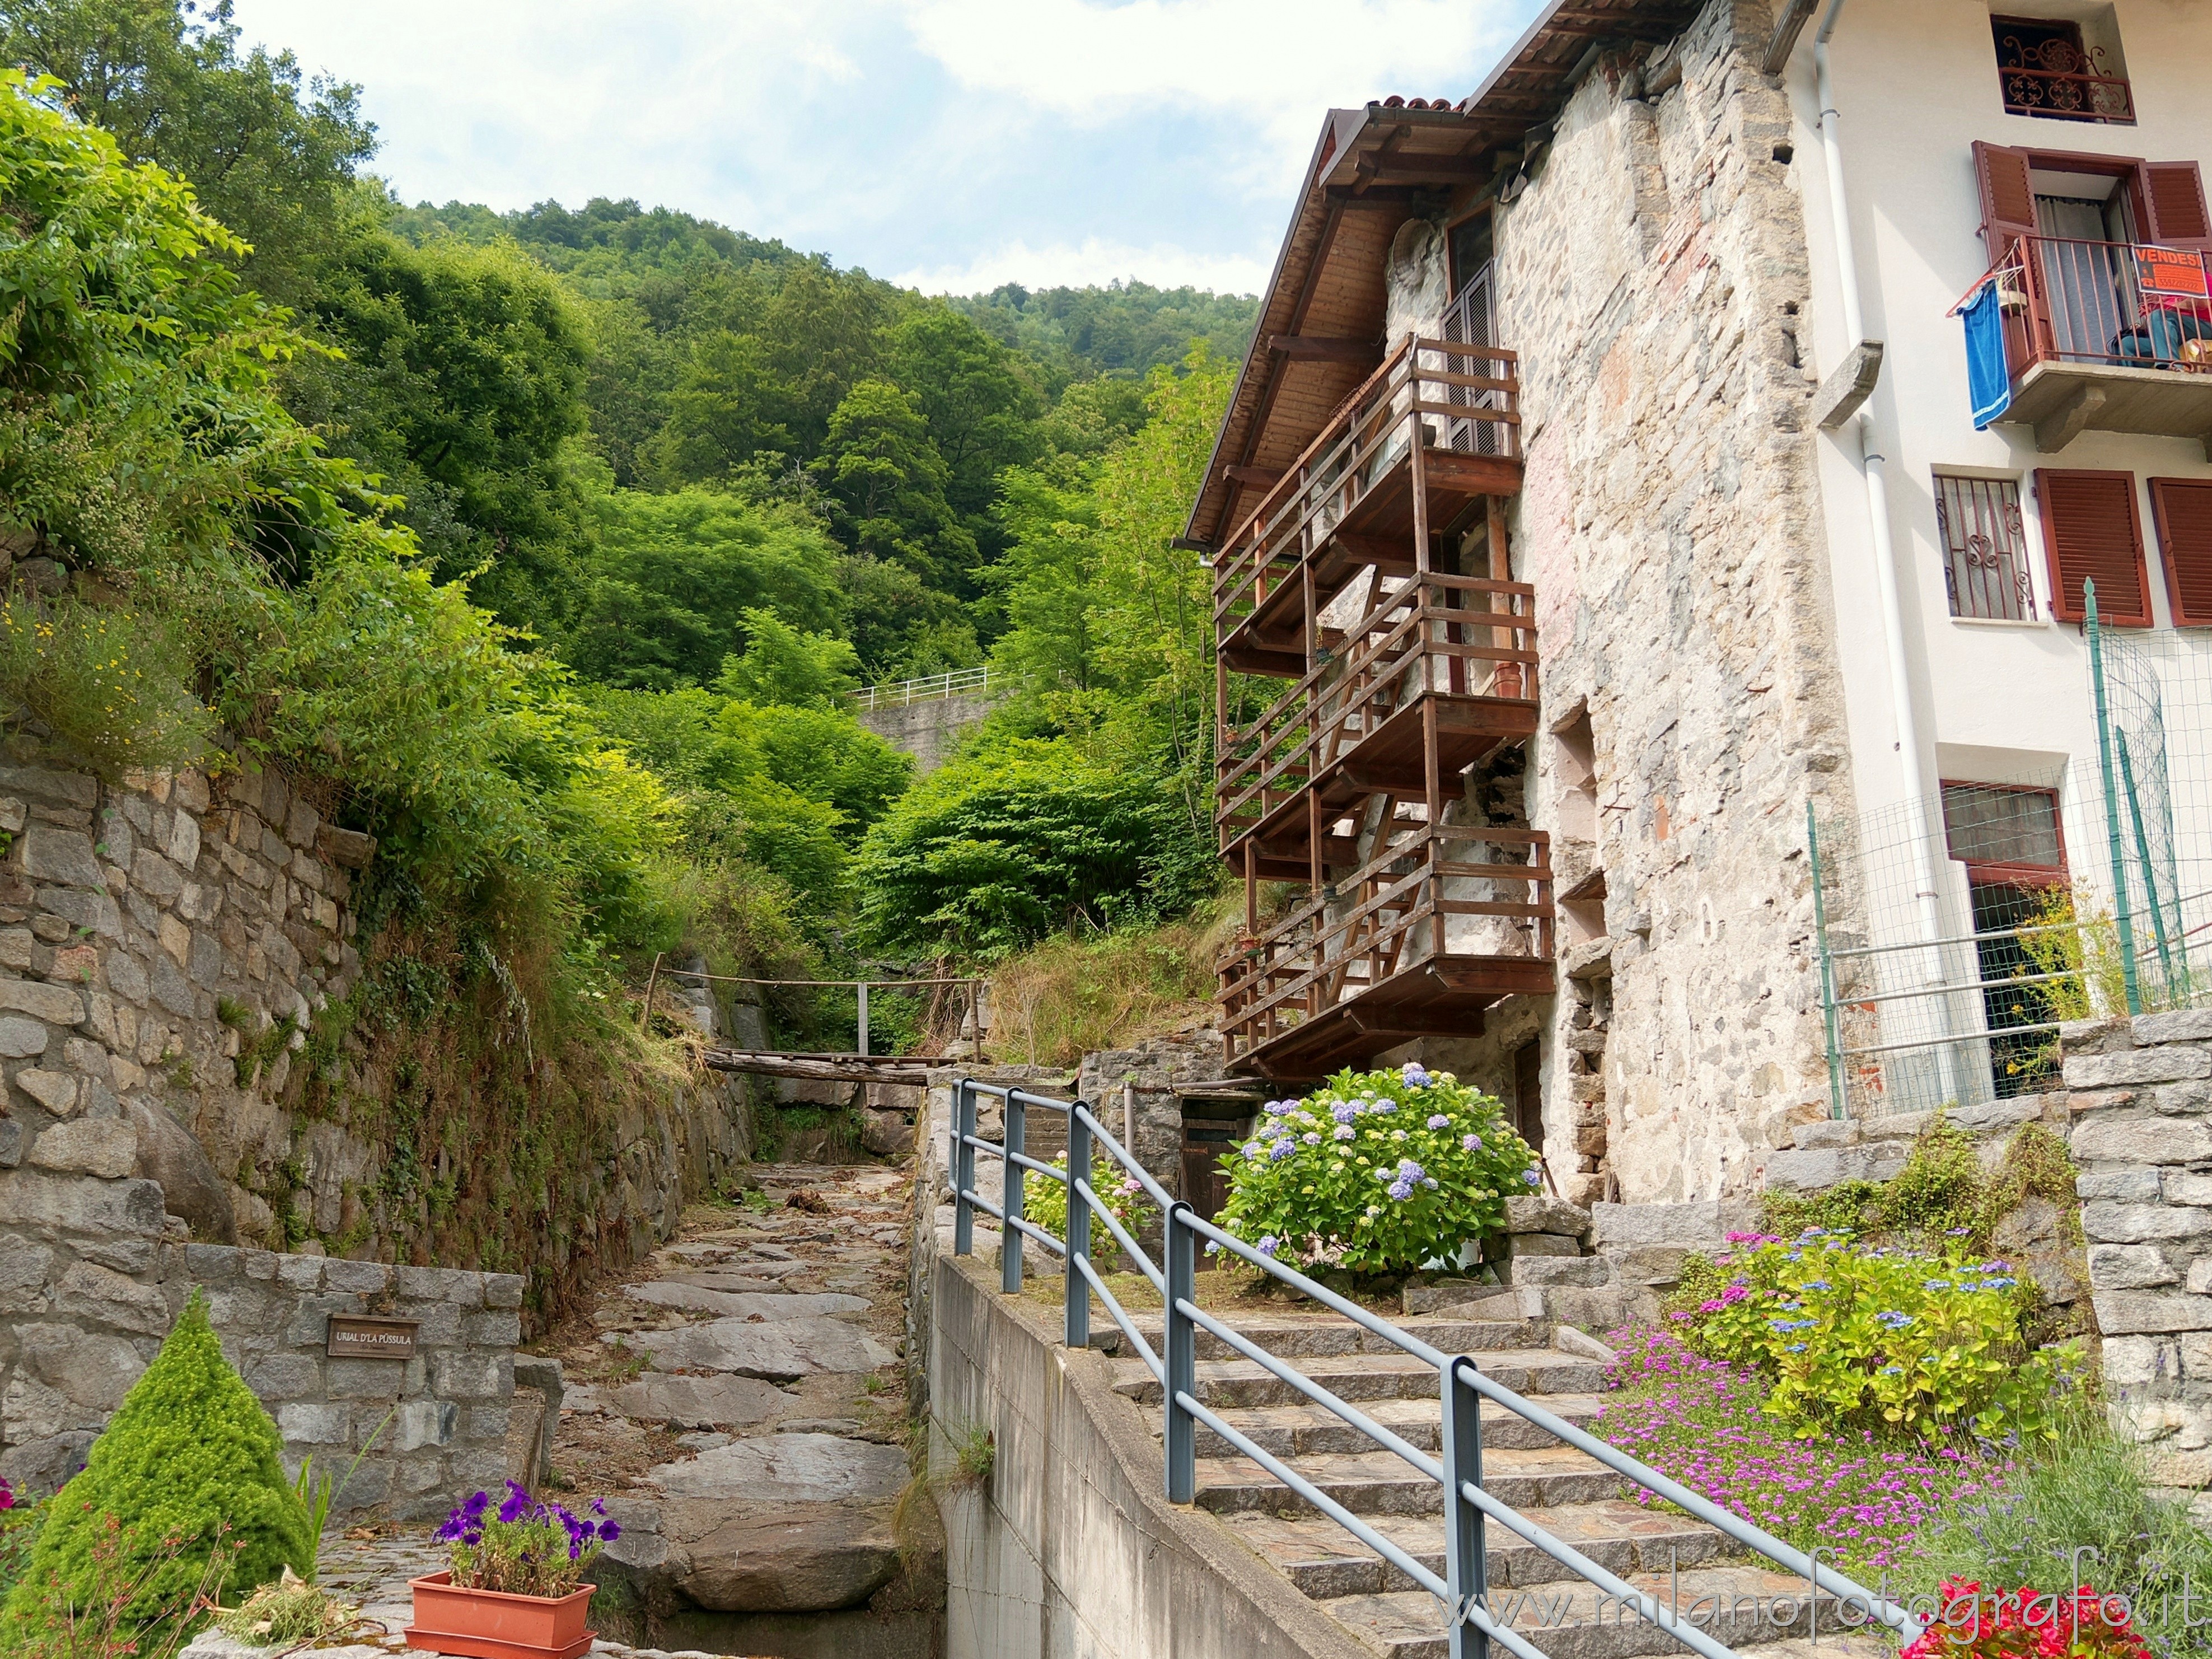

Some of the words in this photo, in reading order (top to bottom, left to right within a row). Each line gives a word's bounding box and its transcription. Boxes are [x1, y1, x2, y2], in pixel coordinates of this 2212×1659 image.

[2135, 249, 2200, 267] VENDESI
[336, 1332, 359, 1342] URIAL
[360, 1333, 377, 1343] D'LA
